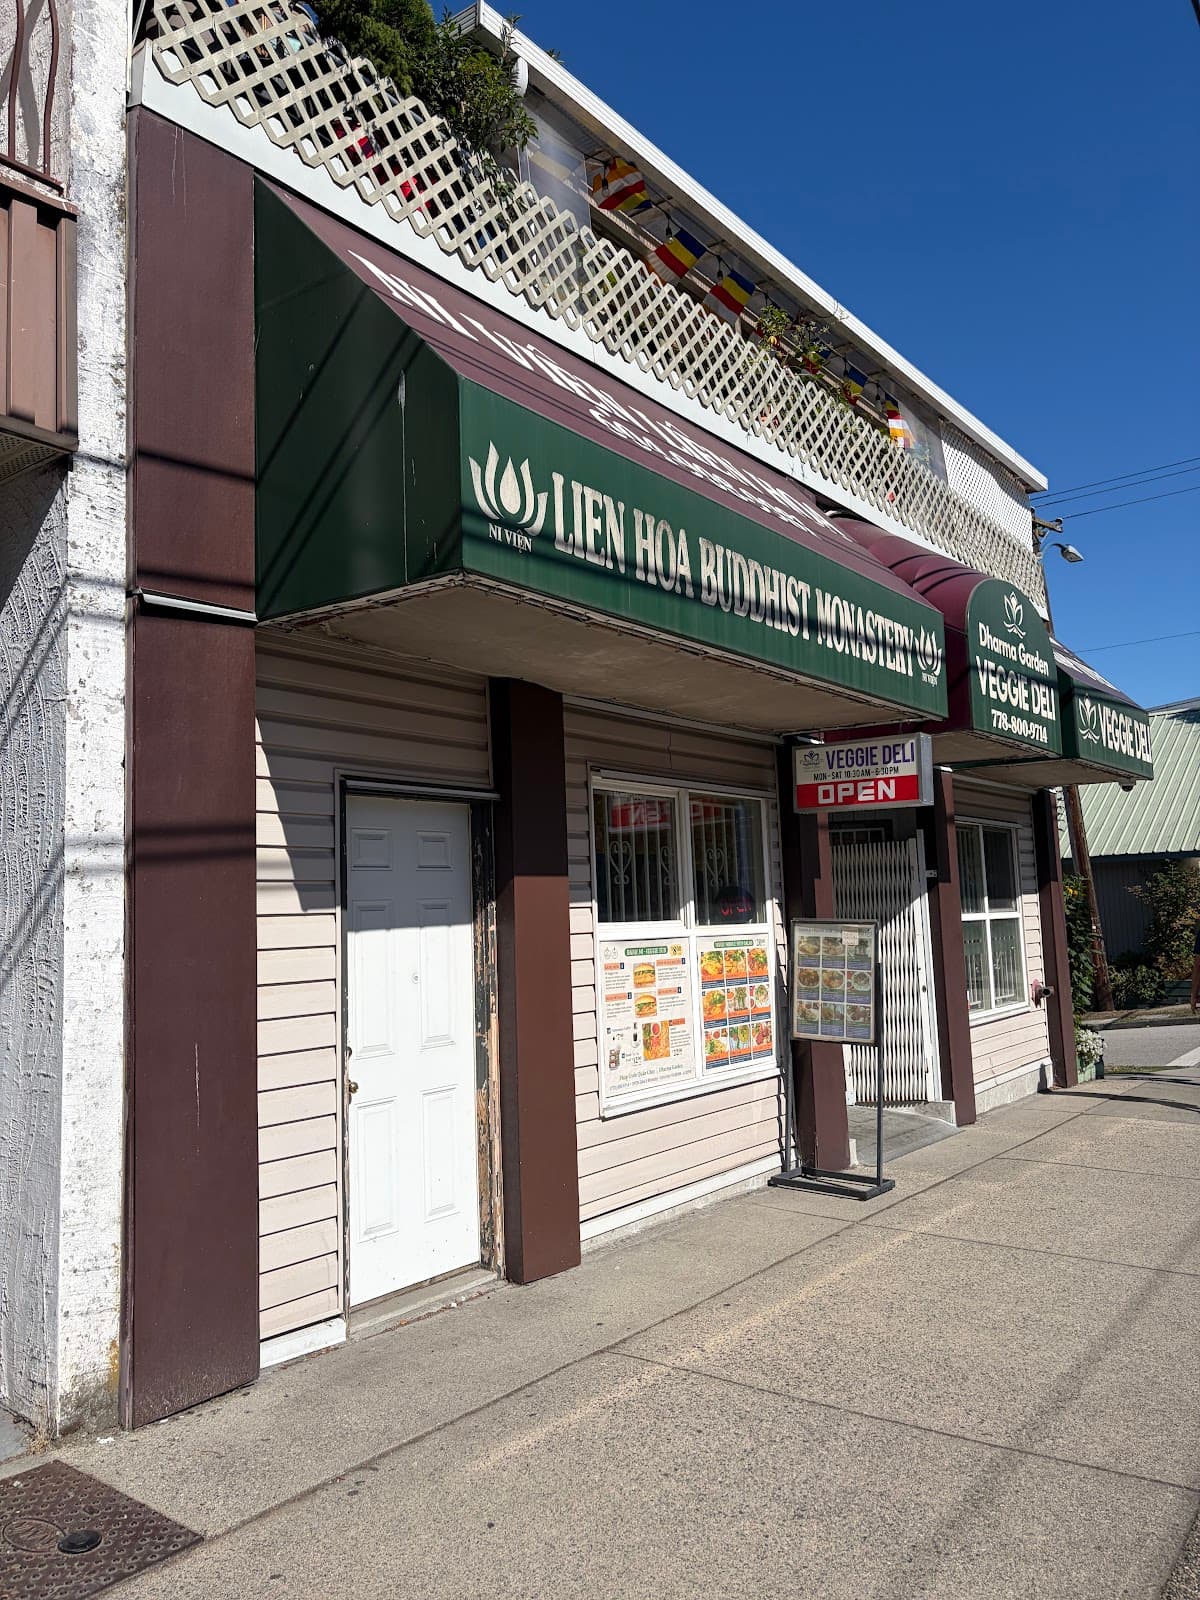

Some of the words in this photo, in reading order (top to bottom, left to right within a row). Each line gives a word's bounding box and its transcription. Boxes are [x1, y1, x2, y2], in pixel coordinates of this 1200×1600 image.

[347, 248, 479, 342] NI
[741, 467, 854, 543] HOA
[488, 523, 503, 542] NI
[503, 528, 532, 554] VIỆN
[552, 471, 626, 575] LIEN
[633, 507, 694, 599] HOA
[699, 536, 812, 641] BUDDHIST
[815, 588, 915, 677] MONASTERY
[978, 622, 1017, 663] Dharma
[1018, 643, 1049, 677] Garden
[976, 655, 1030, 712] VEGGIE
[1031, 679, 1056, 721] DELI
[991, 708, 1049, 744] 778-800-9714
[1097, 703, 1135, 758] VEGGIE
[1133, 719, 1153, 764] DELI
[825, 745, 879, 770] VEGGIE
[882, 741, 915, 765] DELI
[817, 779, 896, 805] OPEN
